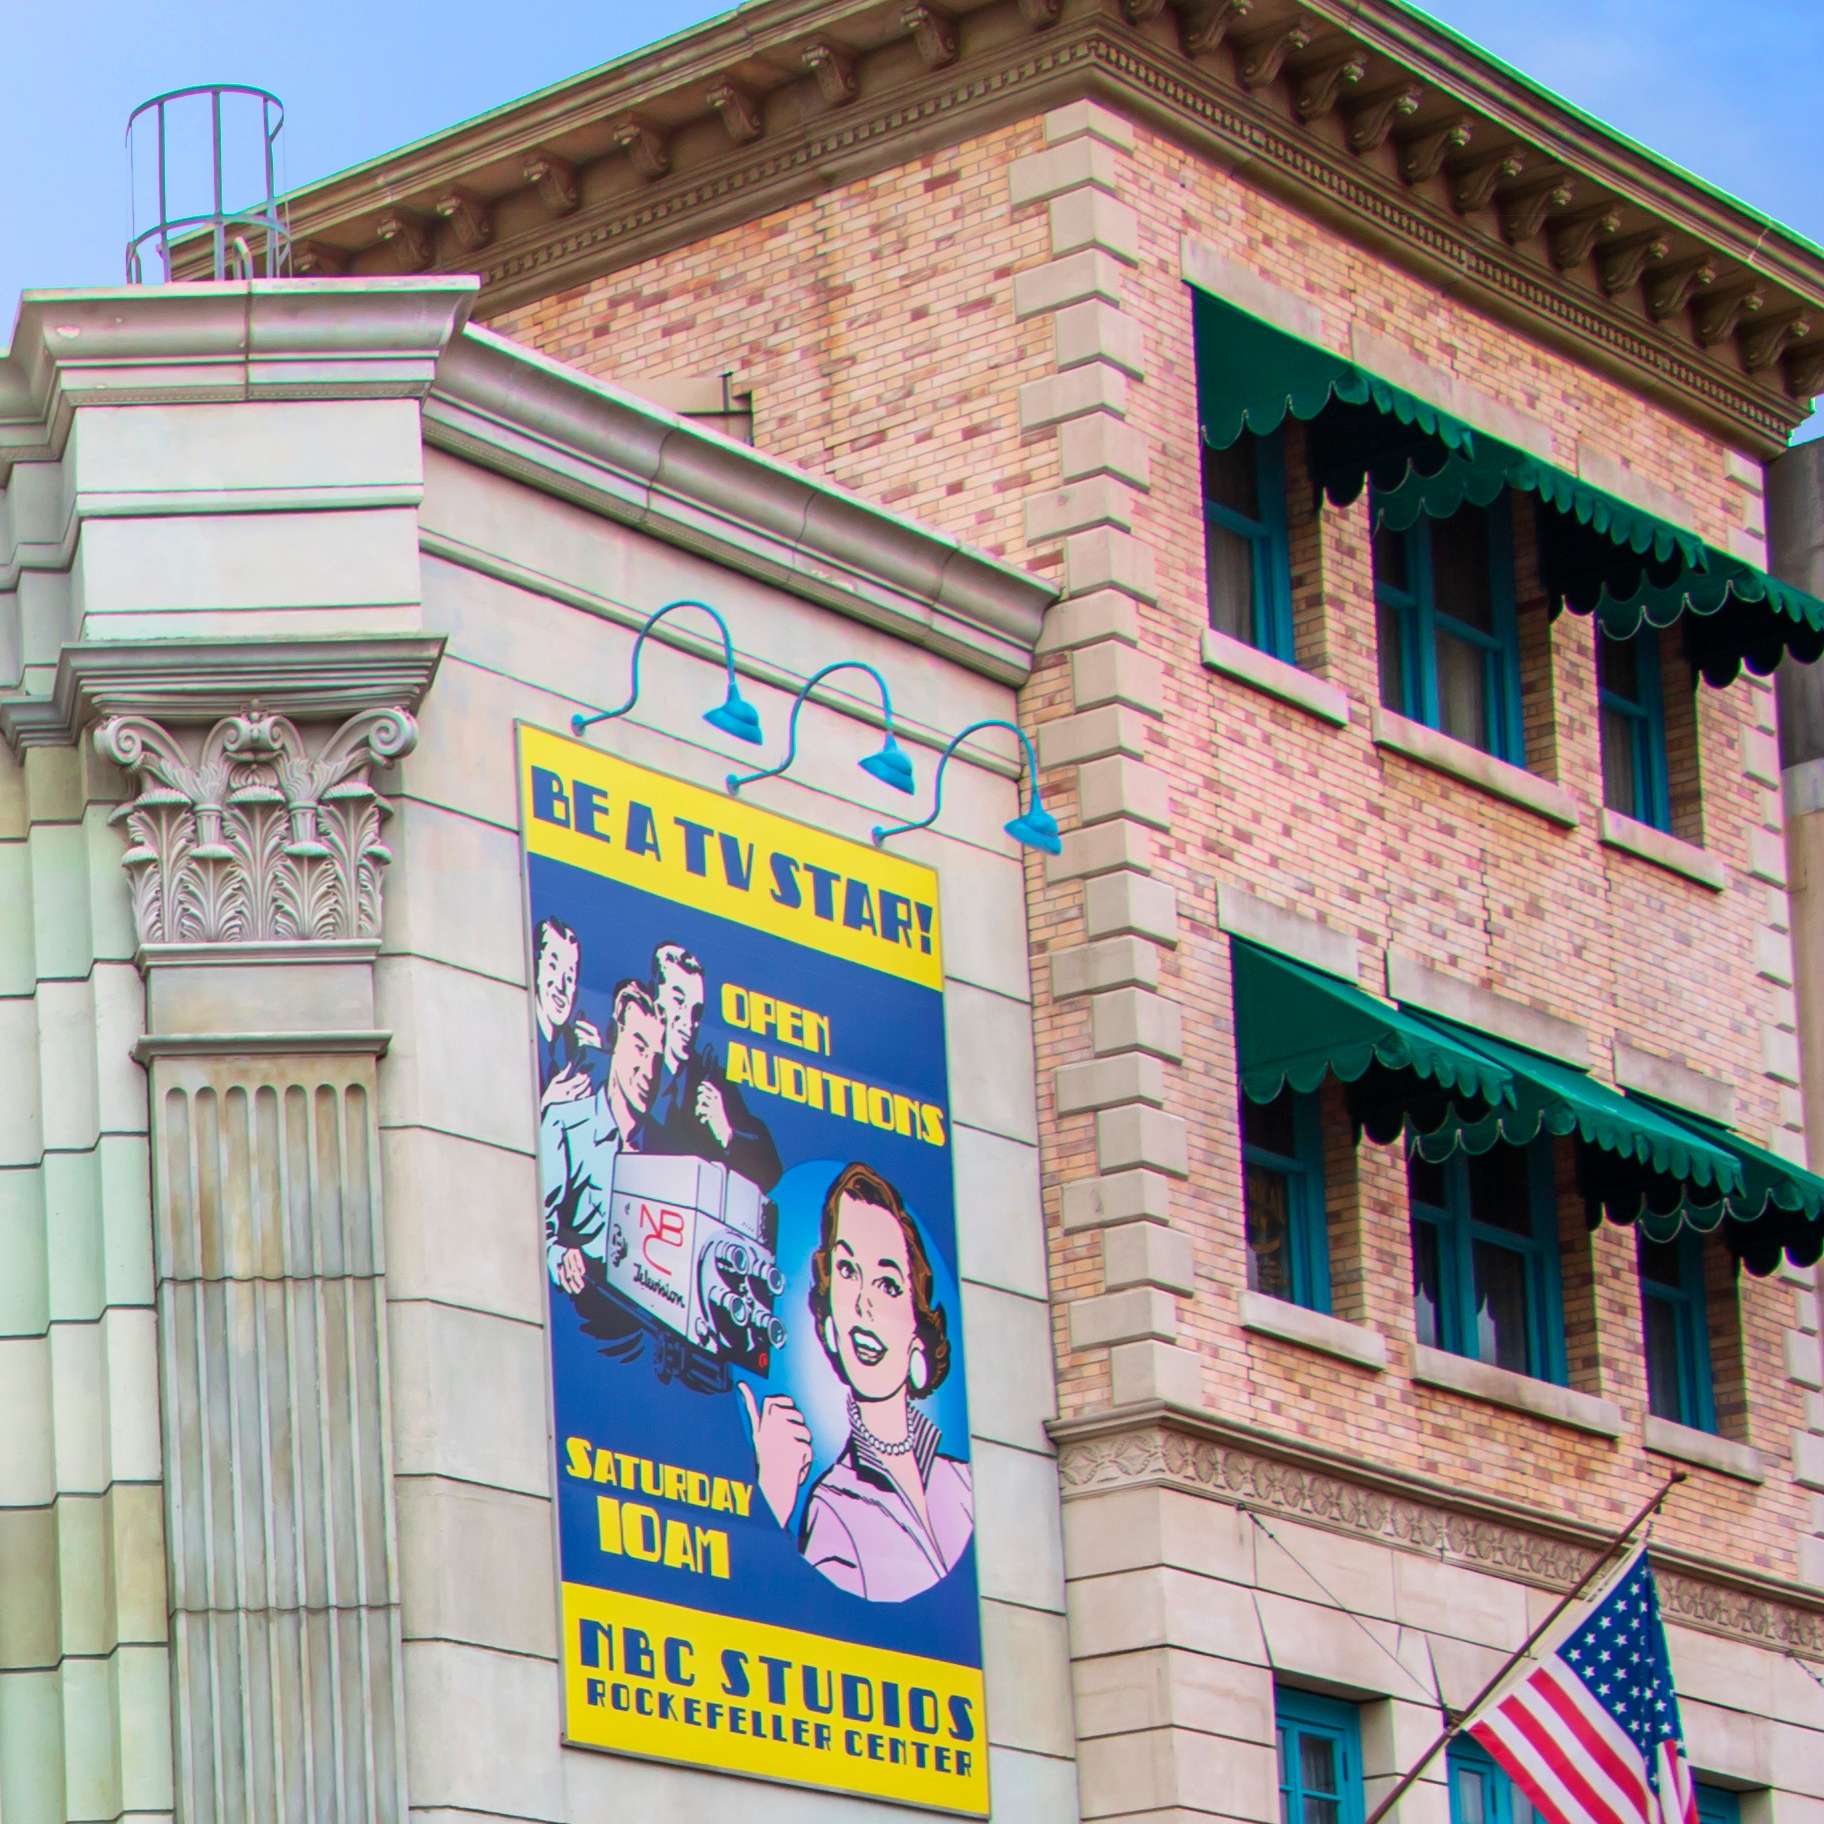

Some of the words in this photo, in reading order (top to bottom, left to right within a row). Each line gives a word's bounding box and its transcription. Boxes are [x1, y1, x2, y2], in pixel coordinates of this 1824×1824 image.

[530, 764, 611, 845] BE
[624, 799, 662, 863] A
[673, 815, 754, 892] TV
[769, 851, 934, 956] STAR!
[720, 981, 831, 1057] OPEN
[725, 1040, 947, 1147] AUDITIONS
[565, 1435, 754, 1518] SATURDAY
[579, 1617, 696, 1687] NBC
[721, 1648, 975, 1743] STUDIOS
[586, 1677, 832, 1752] ROCKEFELLER
[845, 1729, 973, 1778] CENTER
